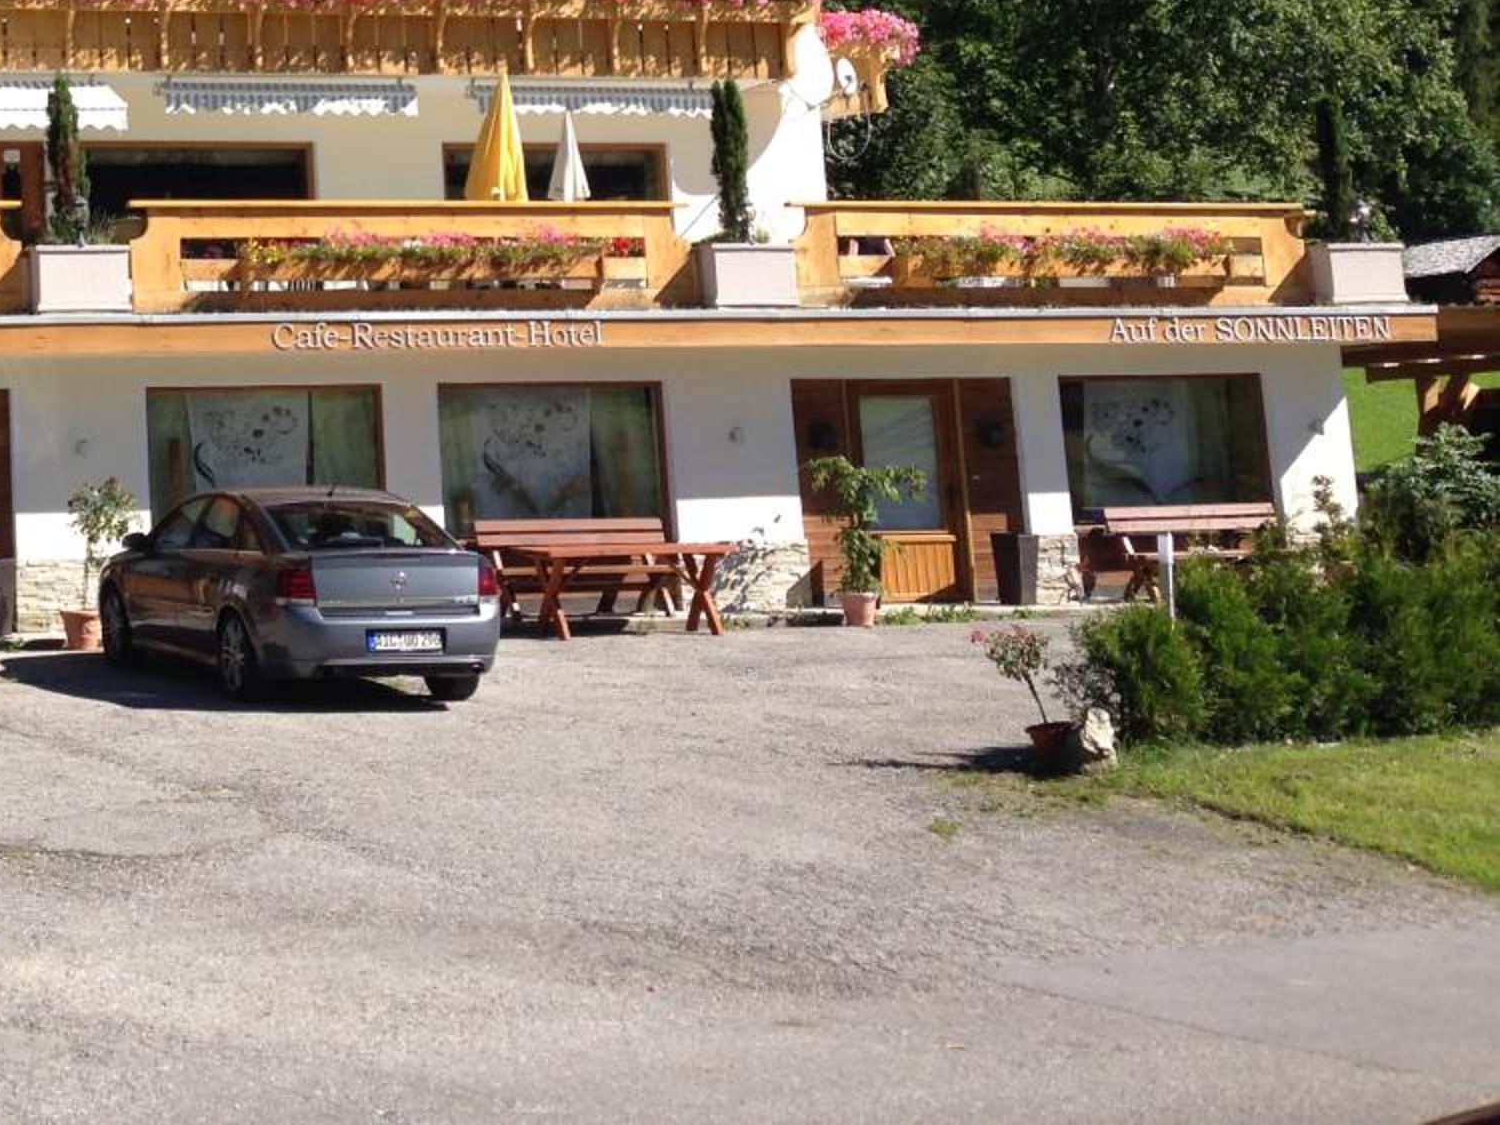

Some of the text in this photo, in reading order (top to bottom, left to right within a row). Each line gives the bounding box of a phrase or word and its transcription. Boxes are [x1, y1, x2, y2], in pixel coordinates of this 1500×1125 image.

[1110, 315, 1392, 343] Auf der SONNLEITEN
